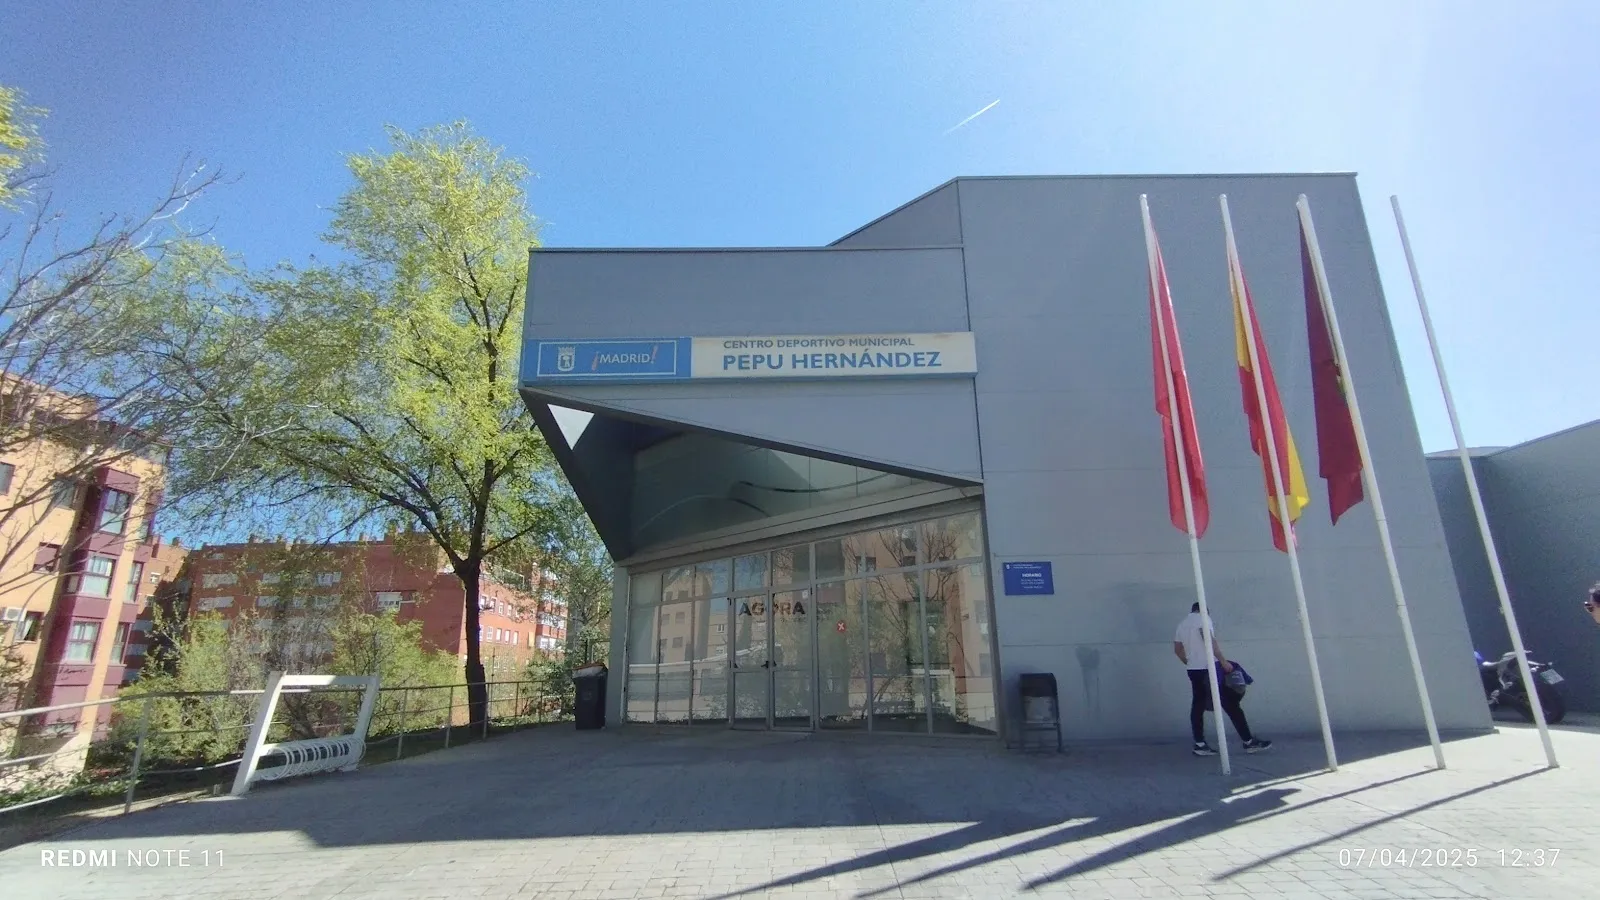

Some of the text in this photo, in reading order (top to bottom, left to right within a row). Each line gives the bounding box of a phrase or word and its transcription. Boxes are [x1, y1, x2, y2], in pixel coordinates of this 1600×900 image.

[723, 337, 915, 349] CENTRO DEPORTIVO MUNICIPAL
[723, 348, 942, 371] PEPU HERNÁNDEZ
